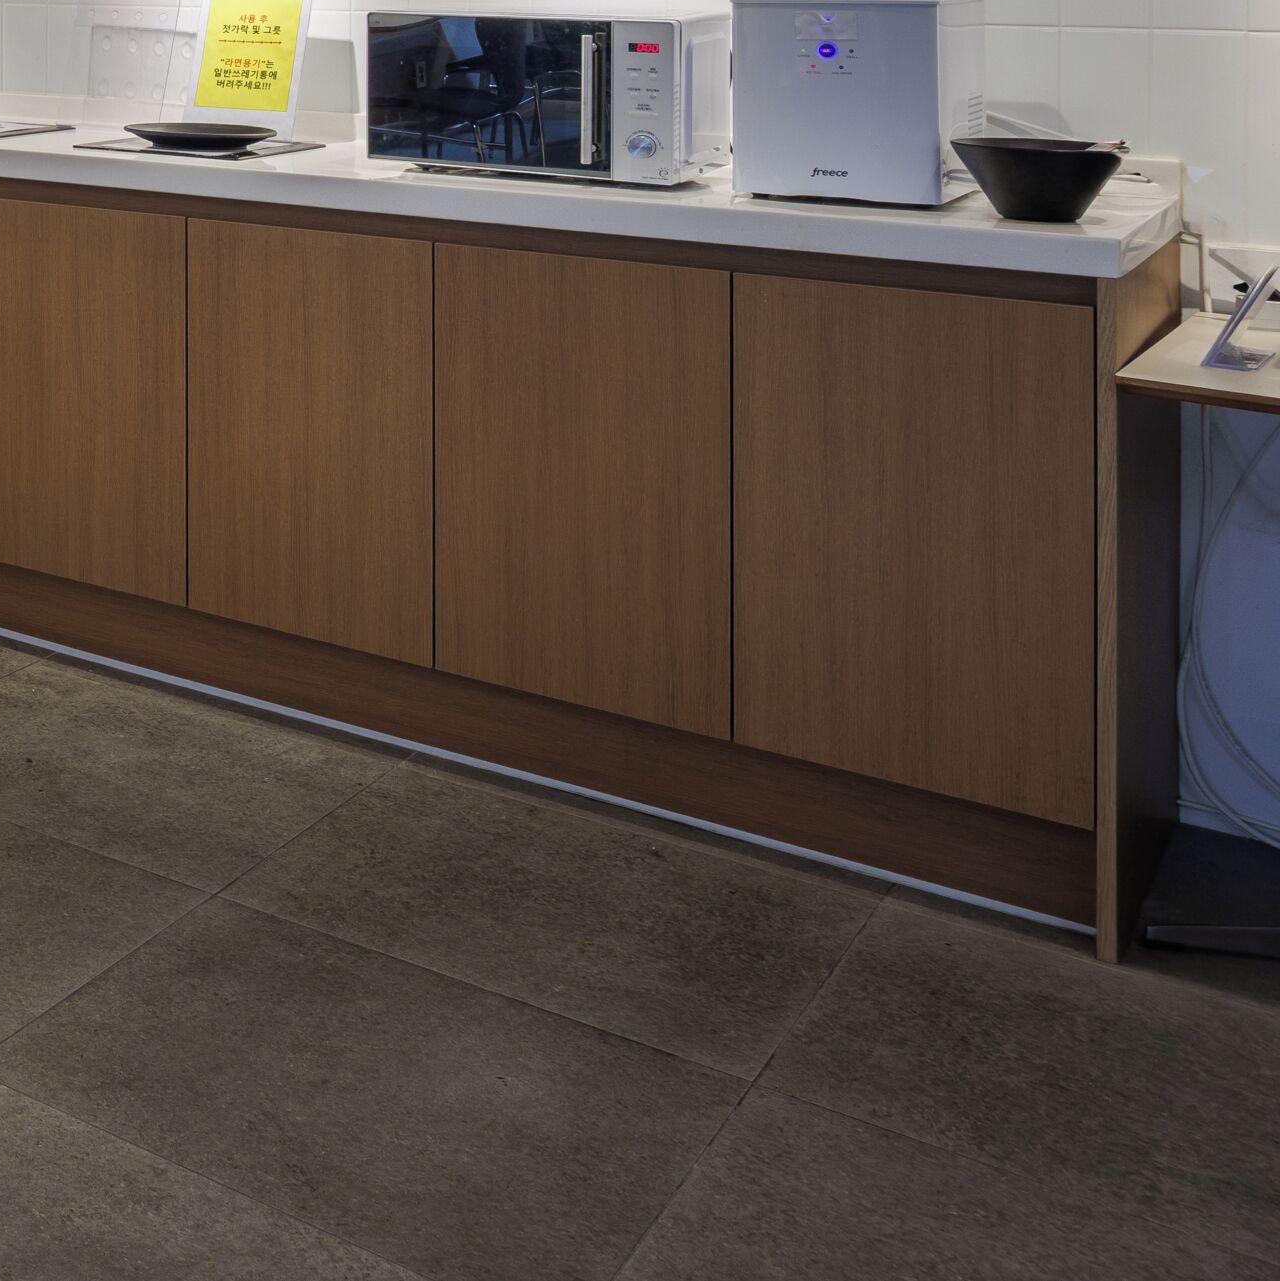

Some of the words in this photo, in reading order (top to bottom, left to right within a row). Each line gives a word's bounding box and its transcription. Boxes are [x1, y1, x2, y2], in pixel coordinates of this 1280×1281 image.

[239, 15, 256, 23] 사용
[260, 15, 268, 24] 후
[222, 24, 249, 34] 젓가락
[252, 25, 260, 35] 및
[263, 25, 281, 35] 그릇
[213, 68, 278, 81] 일반쓰레기통에
[216, 79, 271, 90] 버려주세요!!!
[810, 167, 849, 178] freece
